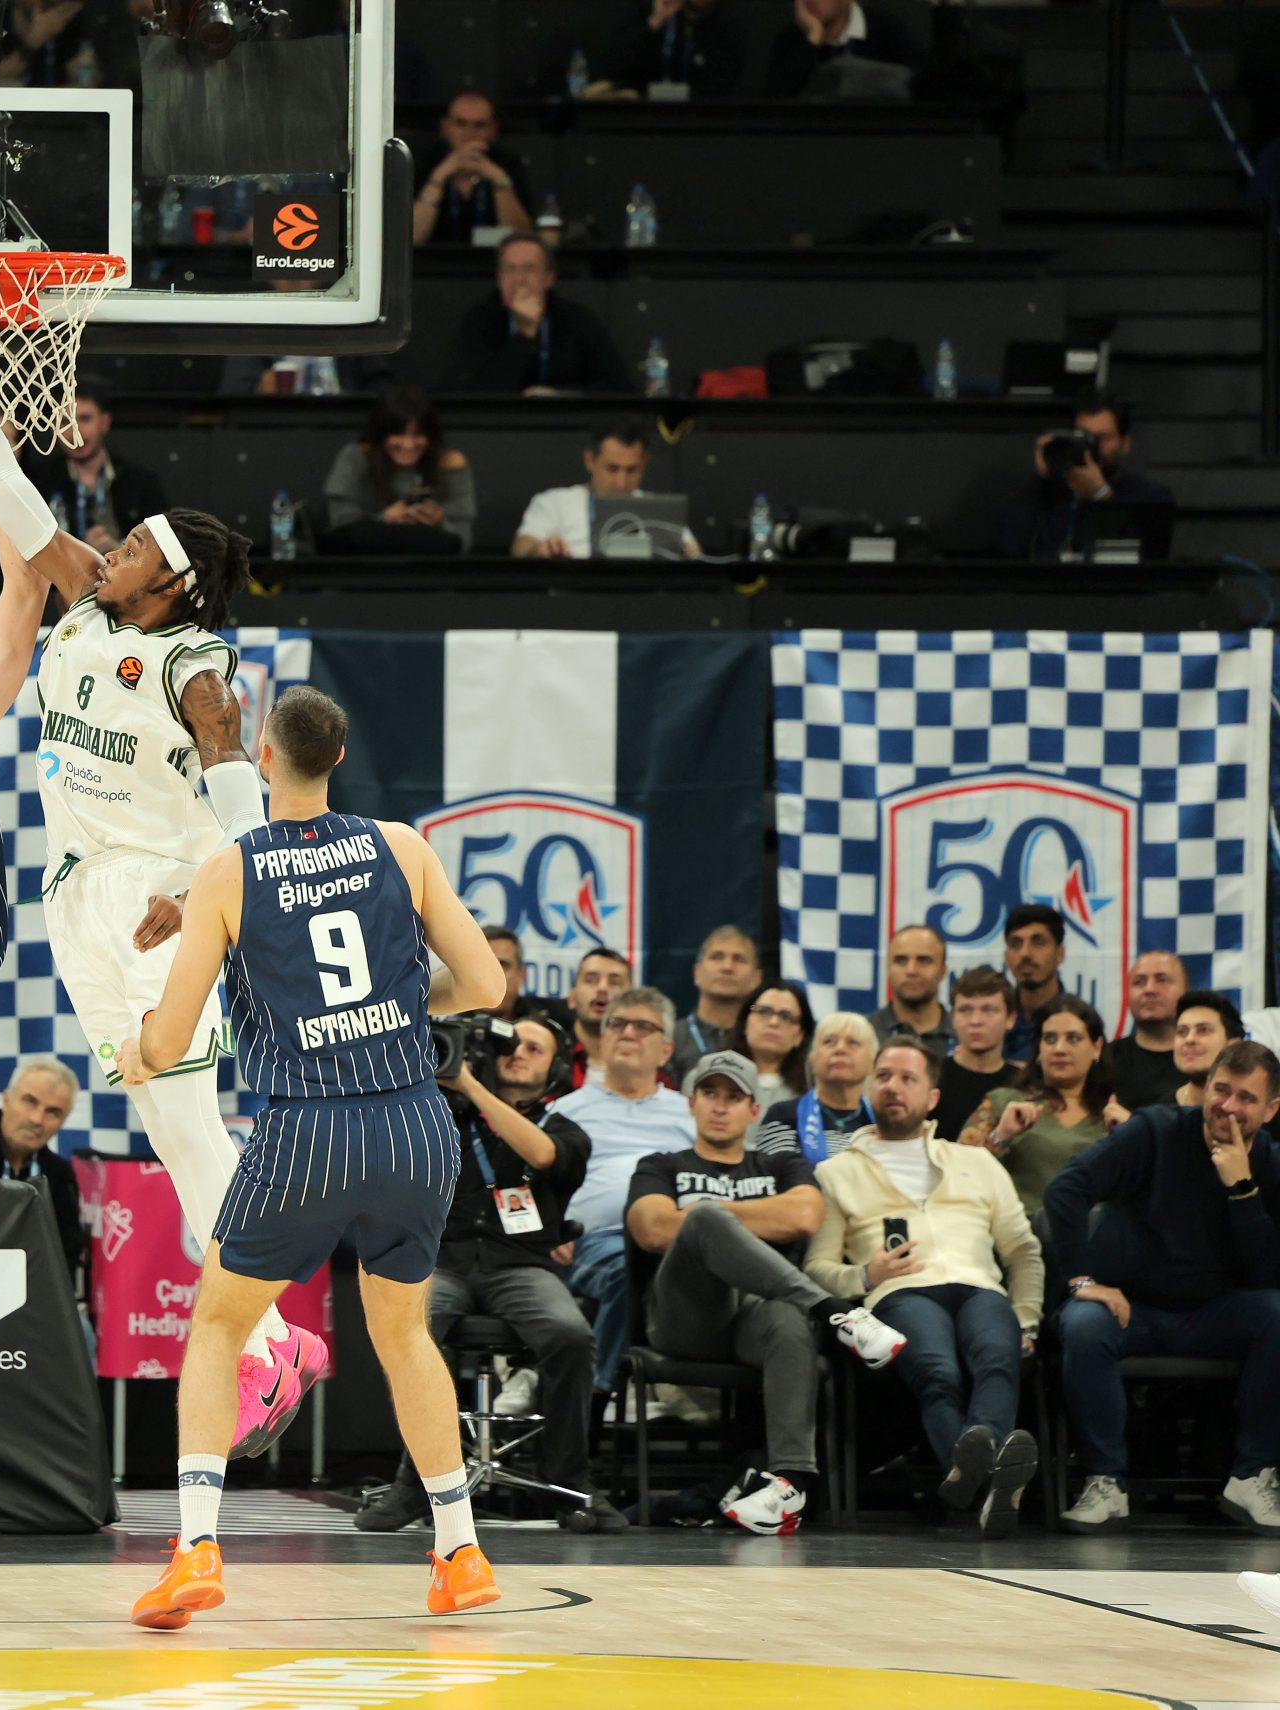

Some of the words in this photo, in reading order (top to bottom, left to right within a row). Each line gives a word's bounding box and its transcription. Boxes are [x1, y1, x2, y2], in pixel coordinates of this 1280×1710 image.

[256, 255, 335, 271] EuroLeague
[76, 674, 95, 711] 8
[63, 777, 132, 803] Προσφοράς
[66, 761, 102, 784] Ομάδα
[252, 834, 378, 881] PAPAGIANNIS
[278, 871, 373, 913] Bilyoner
[925, 816, 1098, 948] 50
[308, 909, 373, 1008] 9
[296, 998, 412, 1051] İSTANBUL
[156, 1279, 200, 1308] Çay
[128, 1312, 192, 1342] Hediy
